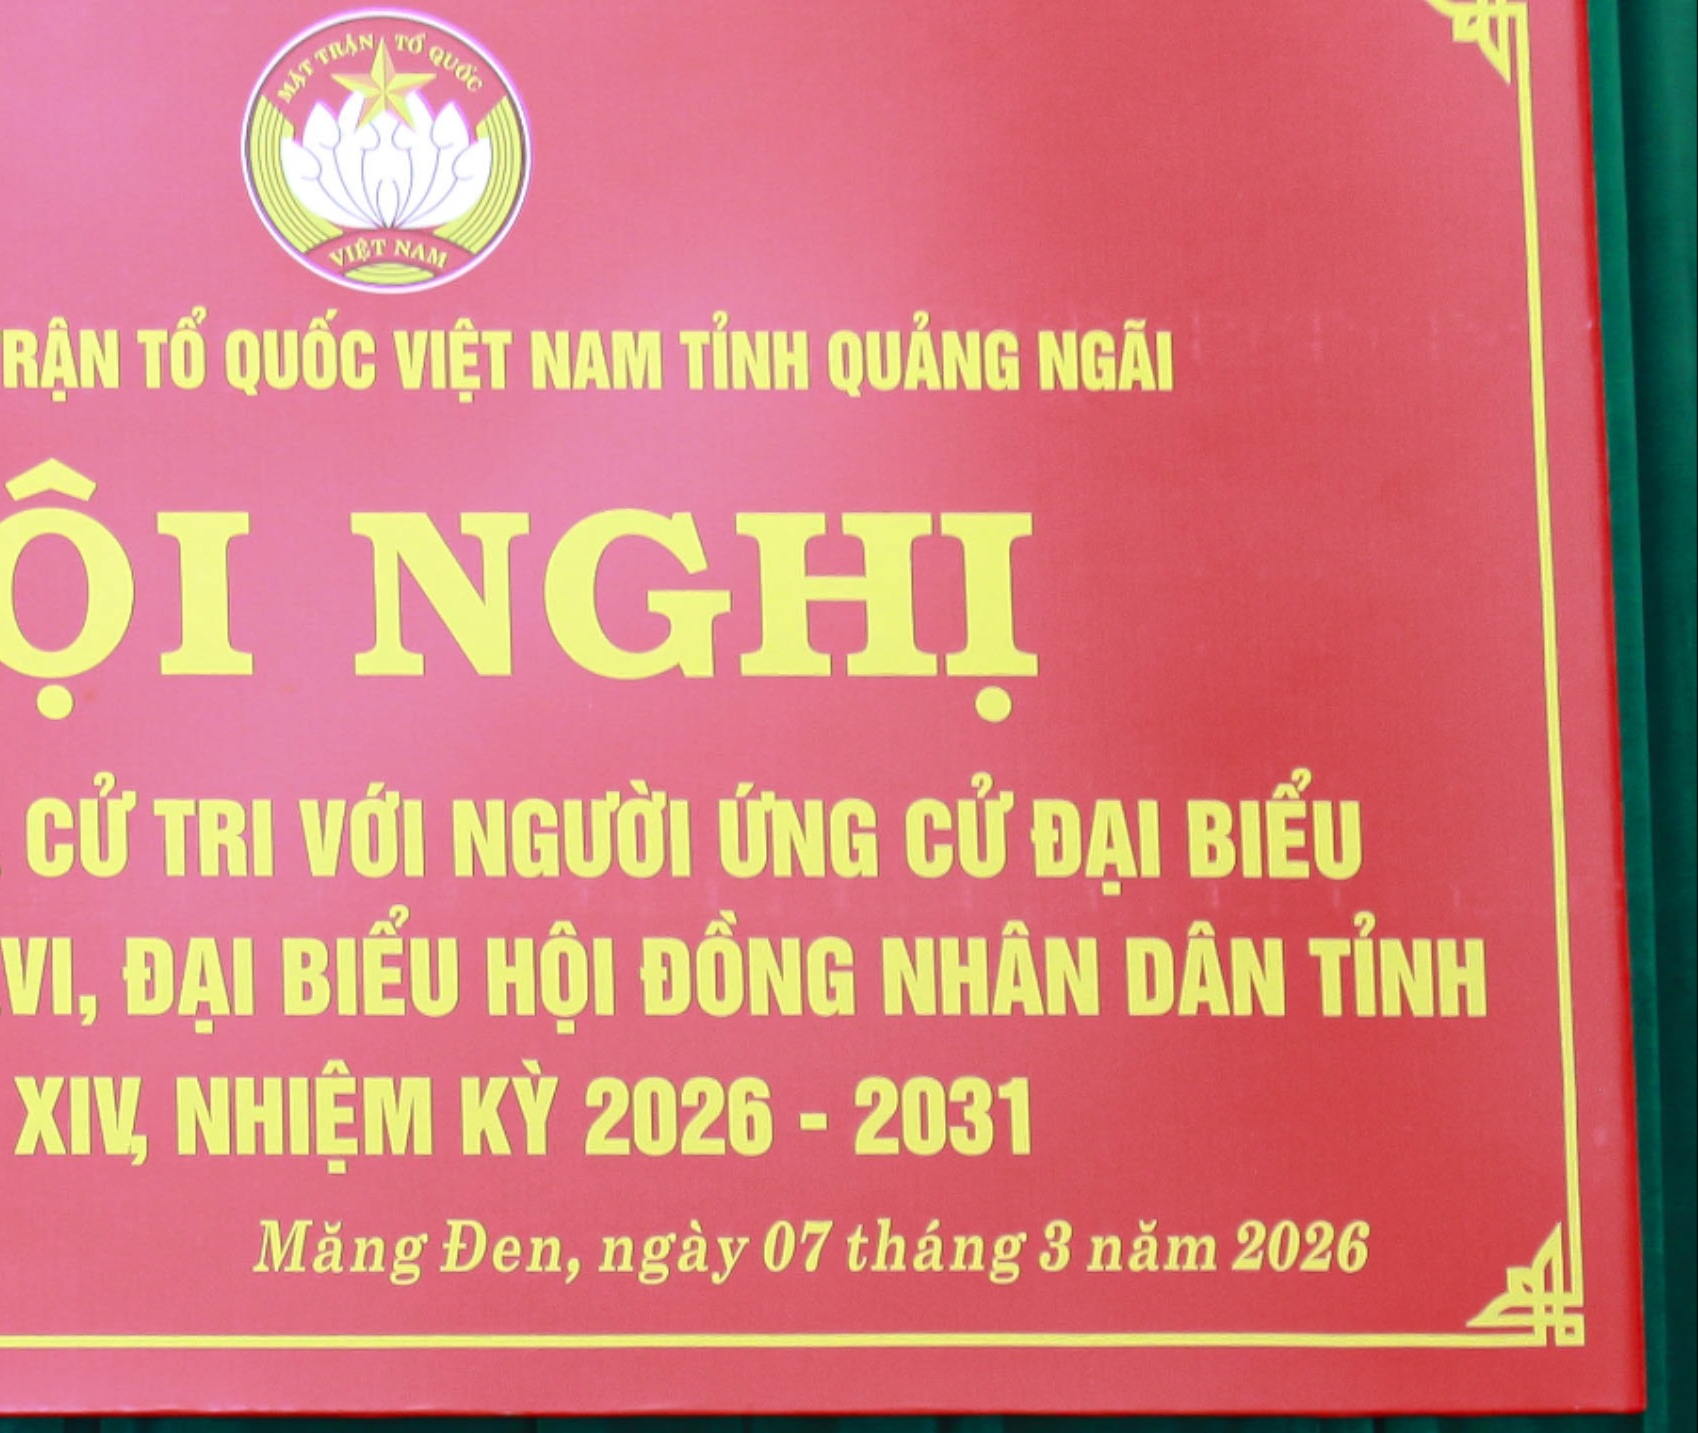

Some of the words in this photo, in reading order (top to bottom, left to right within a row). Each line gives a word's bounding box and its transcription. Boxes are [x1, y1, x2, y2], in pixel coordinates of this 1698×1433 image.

[329, 237, 387, 267] VIỆT
[394, 240, 448, 268] NAM
[137, 306, 207, 389] TỔ
[226, 309, 376, 395] QUỐC
[394, 319, 513, 402] VIỆT
[531, 332, 662, 389] NAM
[680, 312, 809, 389] TỈNH
[829, 312, 1020, 396] QUẢNG
[1039, 321, 1173, 390] NGÃI
[351, 509, 1039, 722] NGHỊ
[26, 772, 137, 877] CỬ
[153, 800, 273, 876] TRI
[299, 783, 424, 877] VỚI
[453, 781, 691, 877] NGƯỜI
[719, 783, 878, 877] ỨNG
[906, 773, 1014, 878] CỬ
[1031, 801, 1160, 895] ĐẠI
[1188, 769, 1361, 879] BIỂU
[123, 938, 254, 1034] ĐẠI
[283, 905, 459, 1016] BIỂU
[487, 921, 614, 1034] HỘI
[640, 911, 855, 1016] ĐỒNG
[883, 921, 1099, 1015] NHÂN
[1126, 922, 1285, 1015] DÂN
[1309, 913, 1487, 1016] TỈNH
[15, 1077, 144, 1165] XIV,
[177, 1061, 432, 1173] NHIỆM
[462, 1060, 558, 1155] KỲ
[586, 1078, 773, 1155] 2026
[801, 1114, 827, 1130] -
[855, 1077, 1030, 1155] 2031
[255, 1221, 429, 1285] Măng
[443, 1220, 580, 1281] Đen,
[601, 1221, 748, 1284] ngày
[764, 1222, 832, 1271] 07
[848, 1219, 1027, 1283] tháng
[1039, 1221, 1072, 1270] 3
[1089, 1223, 1216, 1271] năm
[1233, 1221, 1370, 1271] 2026
